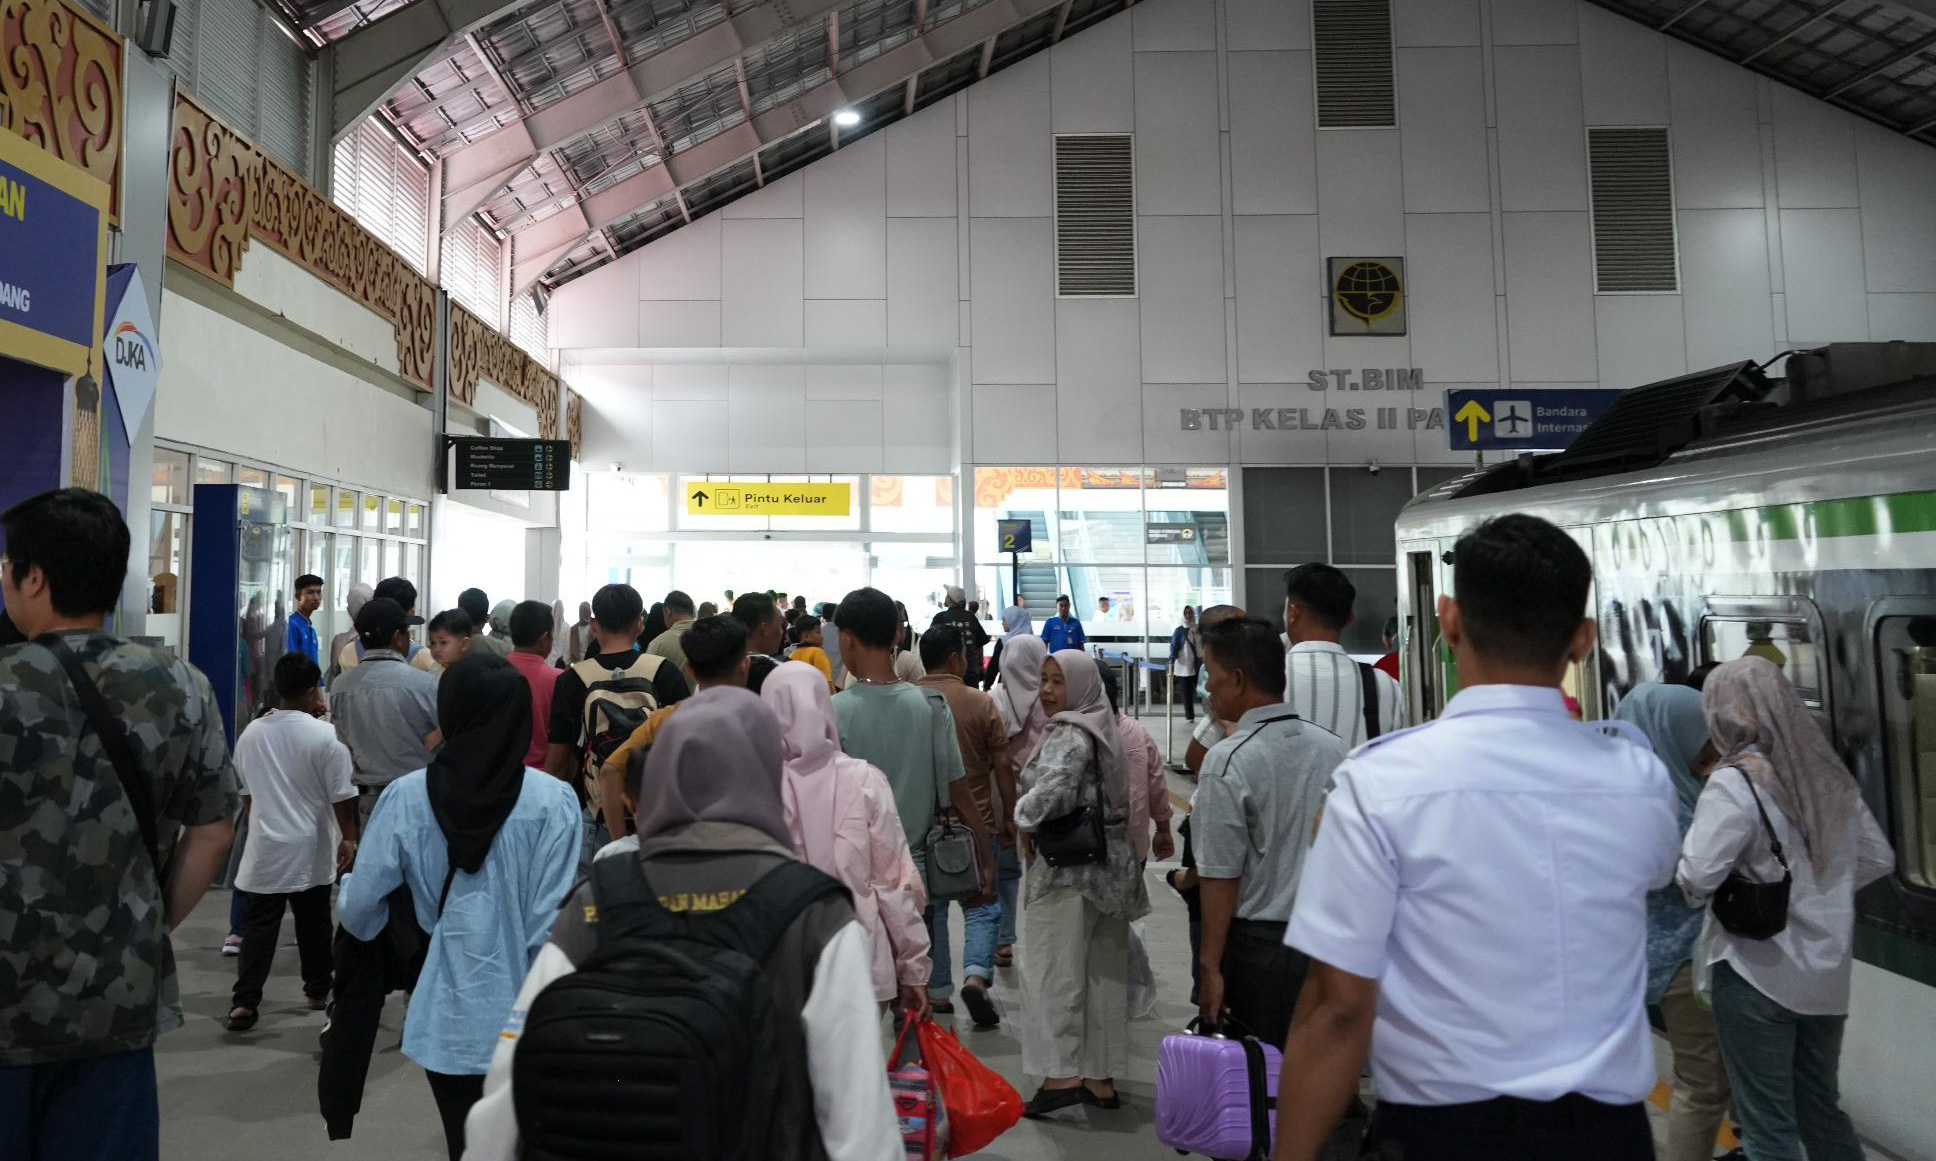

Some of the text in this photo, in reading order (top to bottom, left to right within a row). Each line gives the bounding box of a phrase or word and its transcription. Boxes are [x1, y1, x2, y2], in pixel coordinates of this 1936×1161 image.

[115, 337, 146, 372] DJKA
[1306, 368, 1425, 392] ST.BIM
[1180, 407, 1245, 431] BTP
[1251, 407, 1367, 431] KELAS
[1377, 407, 1397, 430] II
[1536, 406, 1587, 417] Bandara
[745, 493, 827, 504] Pintu Keluar
[1004, 534, 1015, 548] 2
